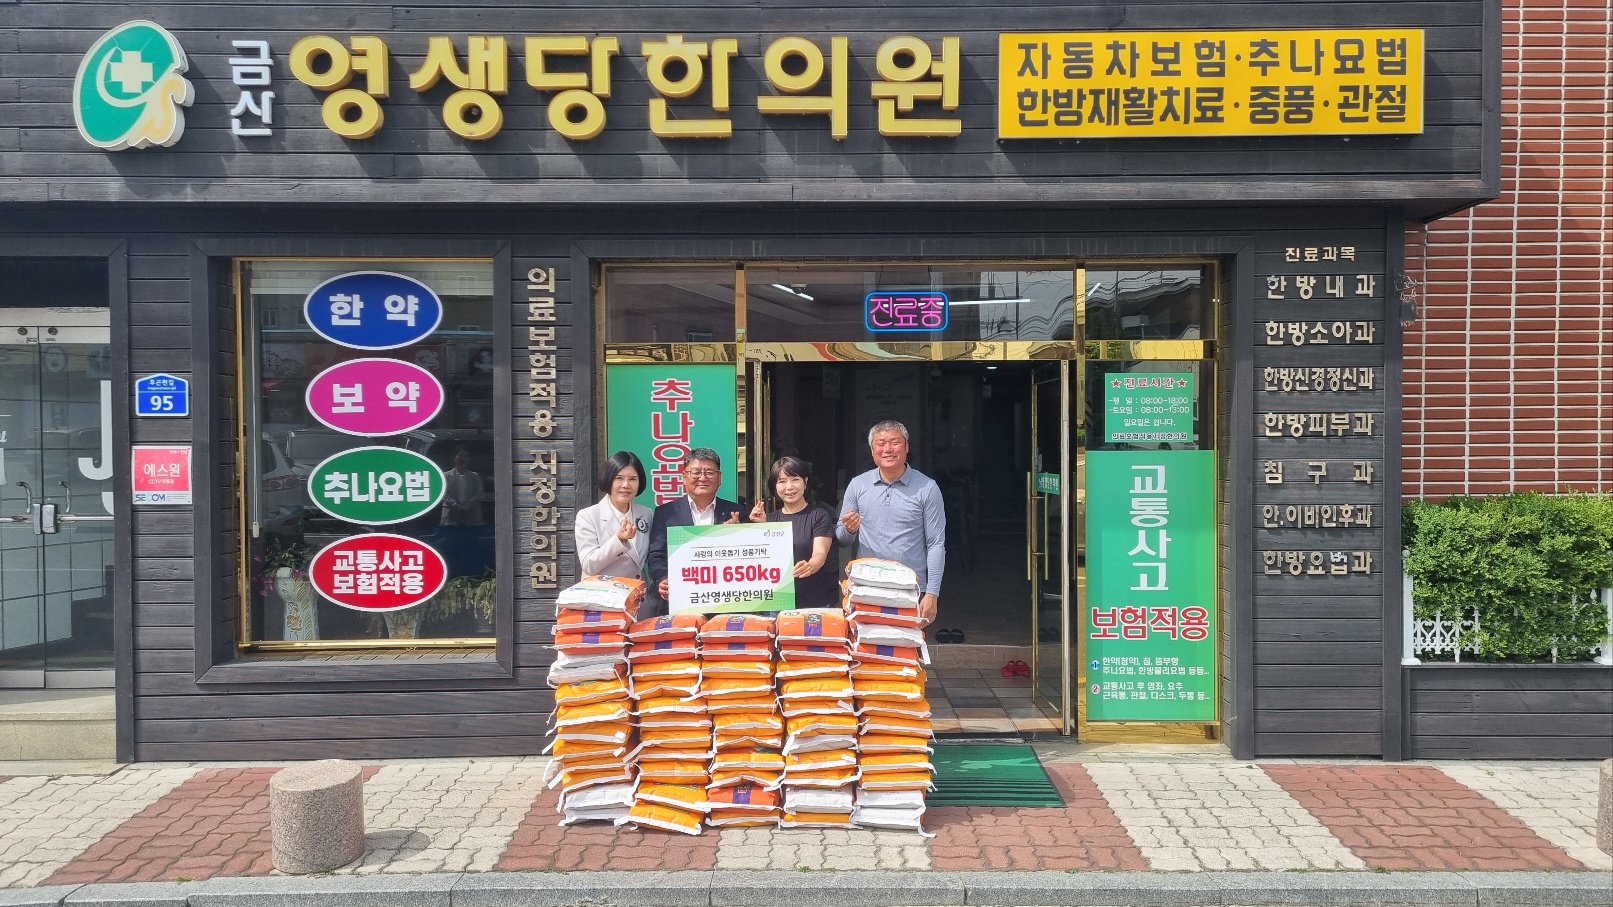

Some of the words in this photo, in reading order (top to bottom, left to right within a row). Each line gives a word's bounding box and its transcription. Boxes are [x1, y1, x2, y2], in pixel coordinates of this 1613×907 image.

[230, 40, 273, 138] 금산
[289, 34, 962, 141] 영생당한의원
[1285, 246, 1356, 262] 진료과목
[870, 297, 942, 327] 진료중
[1265, 321, 1376, 346] 한방소아과
[527, 267, 557, 438] 의료보험적용
[1123, 377, 1175, 389] 진료시간
[1264, 367, 1374, 391] 한방신경정신과
[150, 395, 174, 411] 95
[1124, 418, 1150, 426] 일요일은
[1264, 412, 1374, 437] 한방피부과
[143, 463, 181, 478] 에스원
[324, 470, 430, 504] 추나요법
[529, 449, 560, 589] 지정한의원
[1127, 465, 1172, 591] 교통사고
[332, 550, 424, 573] 교통사고
[694, 550, 713, 559] 사랑의
[1263, 551, 1373, 576] 한방요법과
[332, 573, 424, 596] 보험적용
[682, 566, 717, 585] 백미
[722, 564, 781, 584] 650kg
[690, 589, 774, 604] 금산영생당한의원
[1091, 606, 1209, 640] 보험적용
[1103, 682, 1134, 690] 교통사고
[1137, 682, 1145, 690] 후
[1167, 682, 1184, 690] 요추
